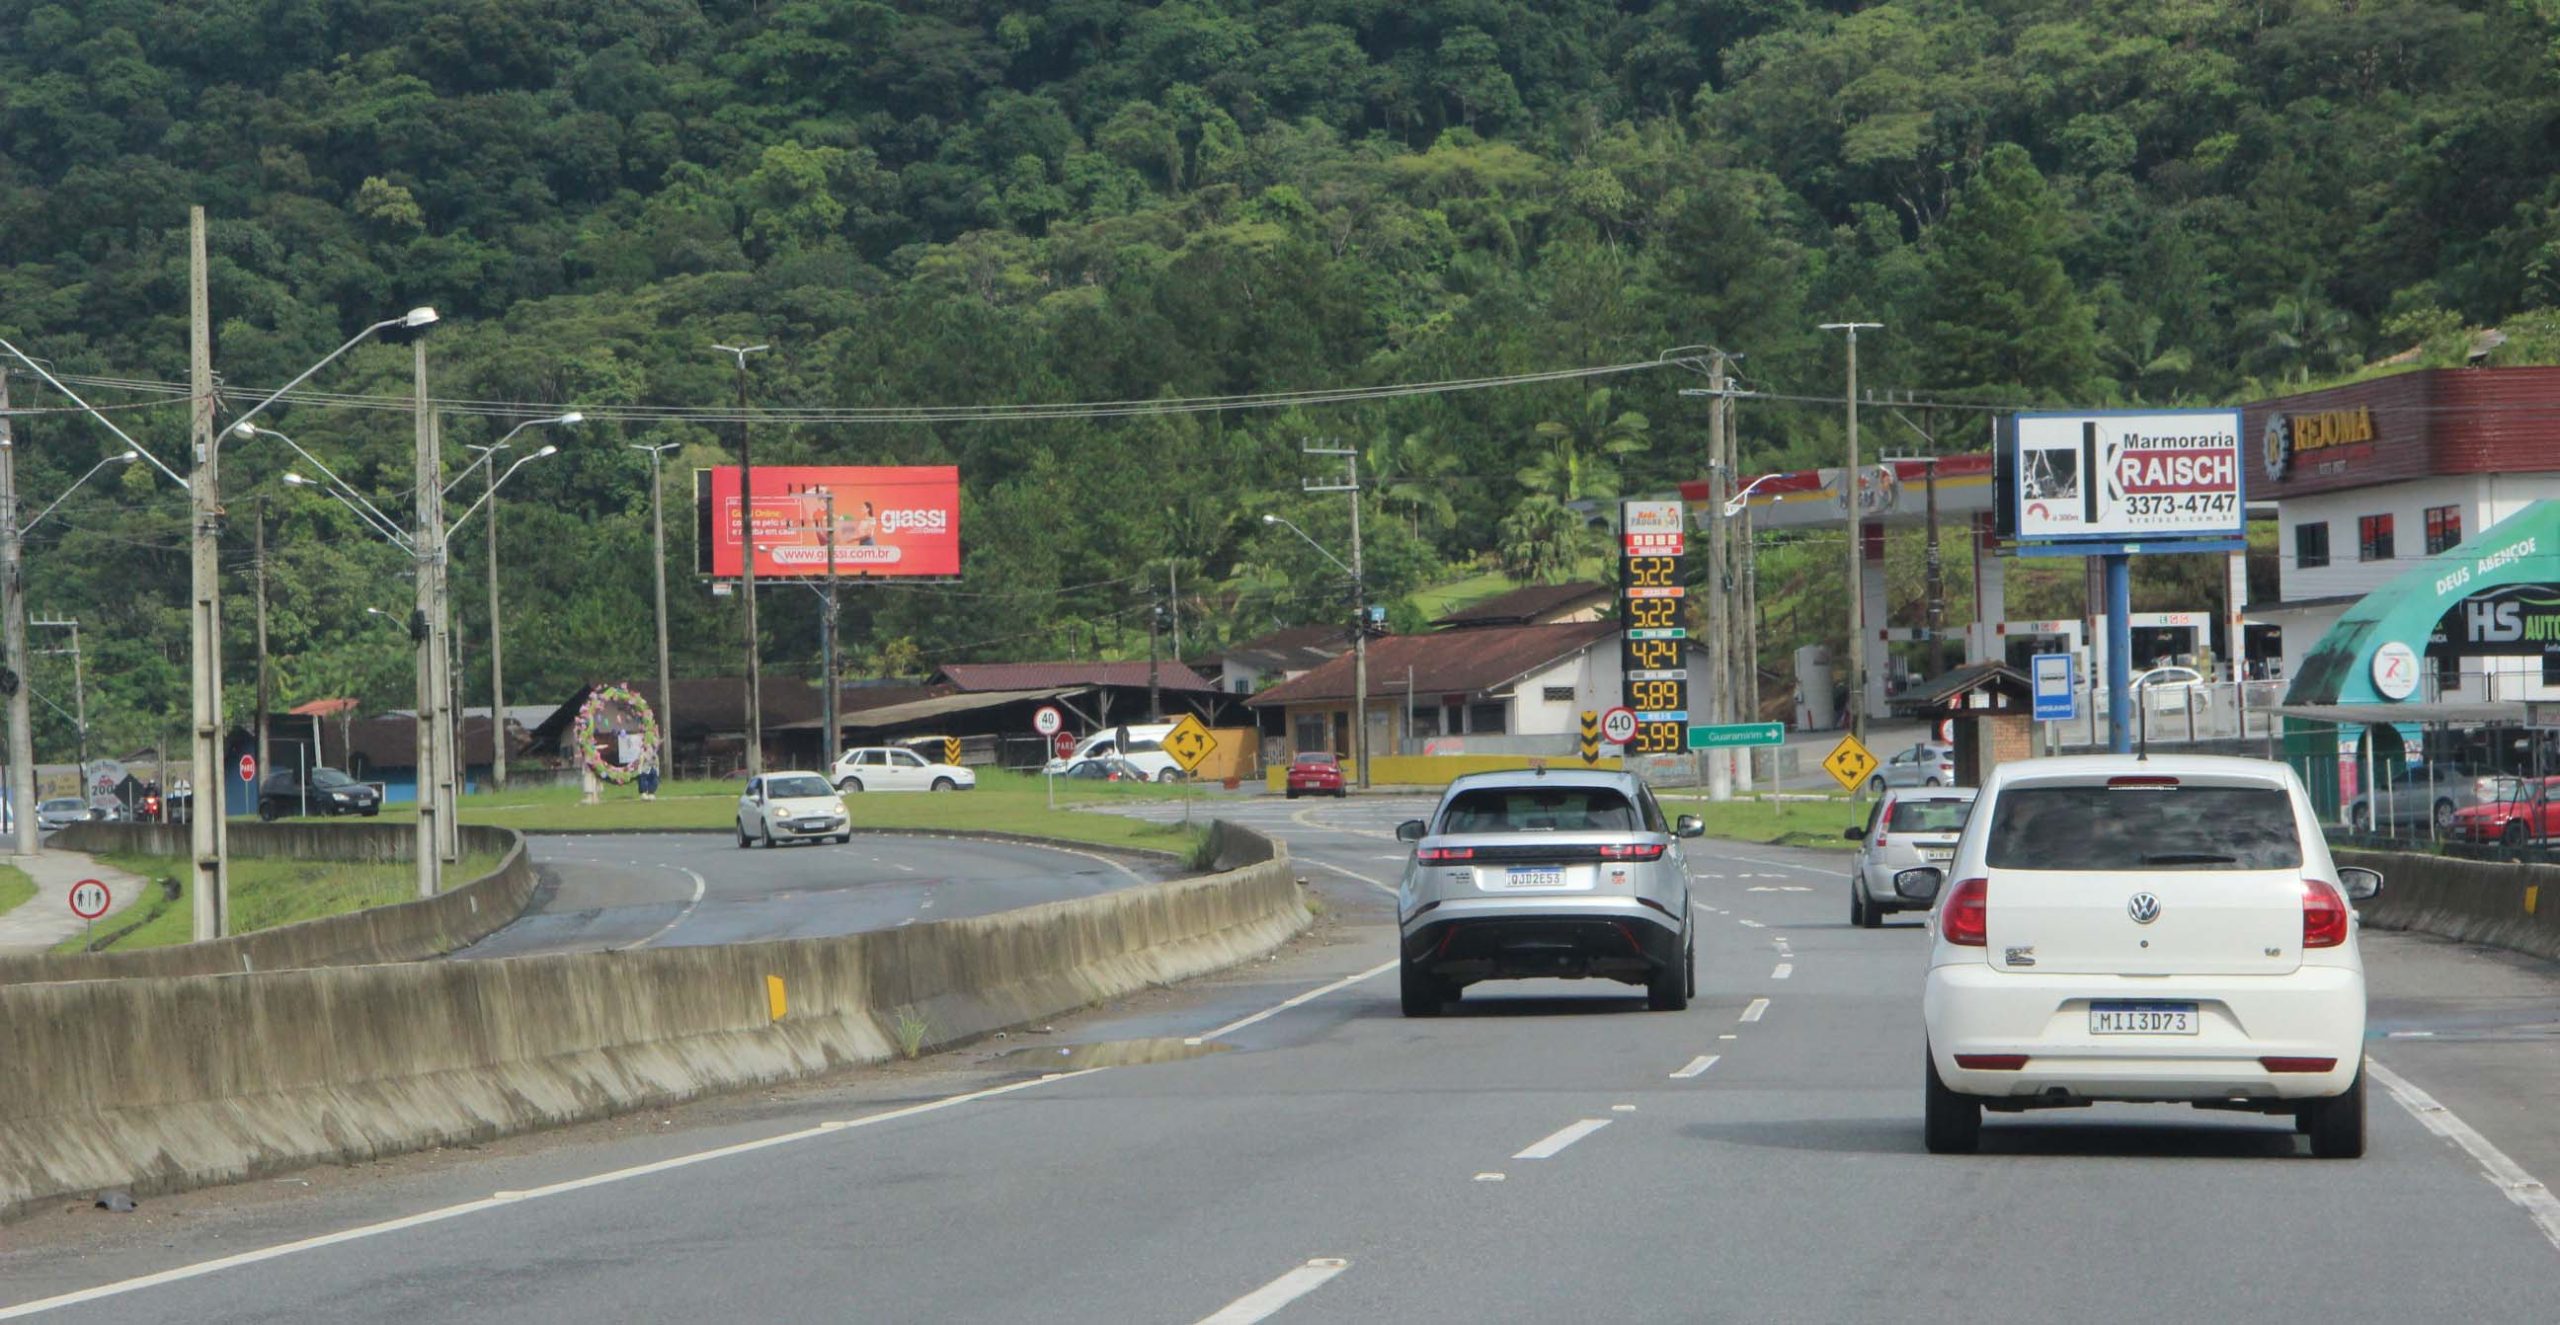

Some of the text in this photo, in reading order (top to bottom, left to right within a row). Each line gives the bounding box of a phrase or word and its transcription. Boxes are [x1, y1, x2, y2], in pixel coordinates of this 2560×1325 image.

[2124, 431, 2234, 449] Marmoraria
[2106, 443, 2233, 500] KRAISCH
[2126, 494, 2236, 515] 3373-4747
[880, 508, 947, 534] giassi
[784, 548, 890, 561] www.gissi.com.br
[1630, 557, 1675, 586] 5.22
[2436, 536, 2537, 597] DEUS ABENÇOE
[1631, 598, 1676, 628] 5.22
[2467, 601, 2523, 642] HS
[1631, 639, 1678, 669] 4.24
[1632, 680, 1679, 711] 5.89
[1041, 712, 1054, 724] 40
[1607, 714, 1632, 732] 40
[1056, 741, 1075, 750] PARE
[1635, 722, 1680, 752] 5.99
[1708, 731, 1763, 742] Guaramirim
[240, 763, 254, 773] PARE
[2100, 1012, 2187, 1031] MII3D73
